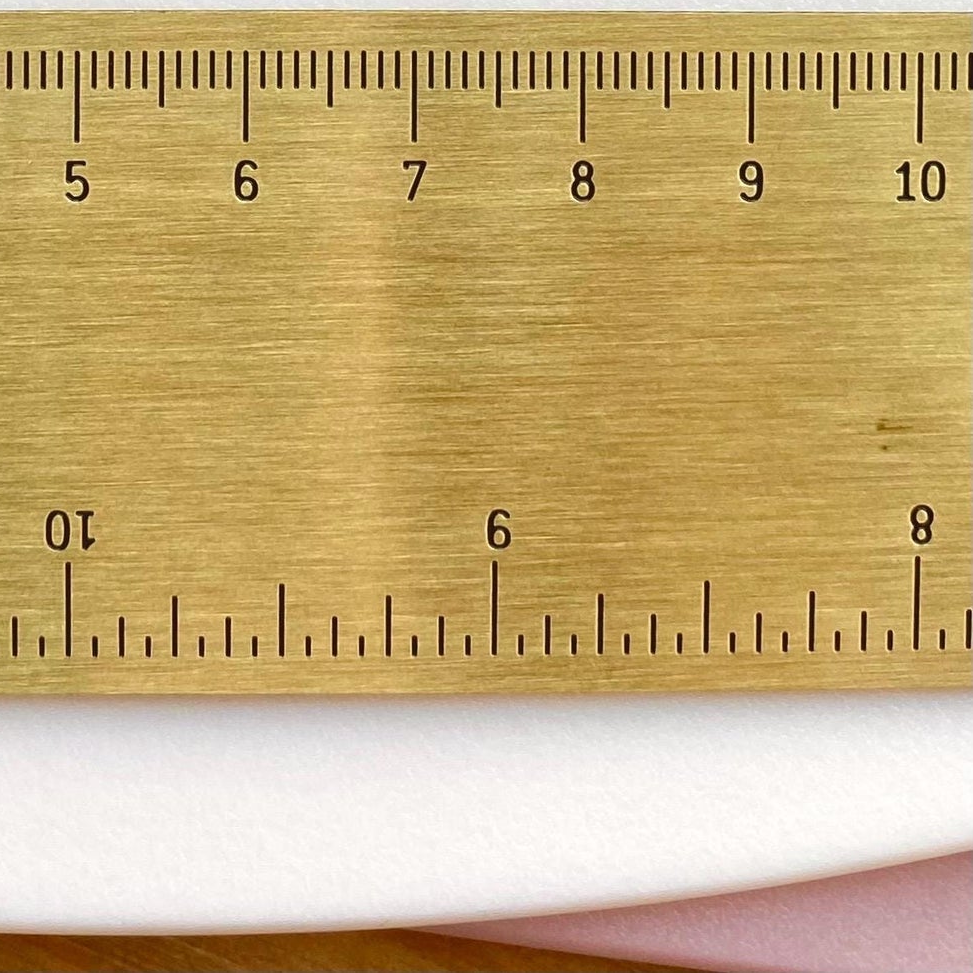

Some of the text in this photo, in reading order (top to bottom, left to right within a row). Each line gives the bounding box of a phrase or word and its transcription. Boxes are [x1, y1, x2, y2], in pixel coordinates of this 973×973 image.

[65, 160, 90, 202] 5
[234, 159, 259, 202] 6
[402, 160, 427, 202] 7
[570, 160, 596, 202] 8
[739, 160, 764, 203] 9
[895, 160, 946, 202] 10
[45, 509, 96, 551] 10
[910, 504, 935, 545] 8
